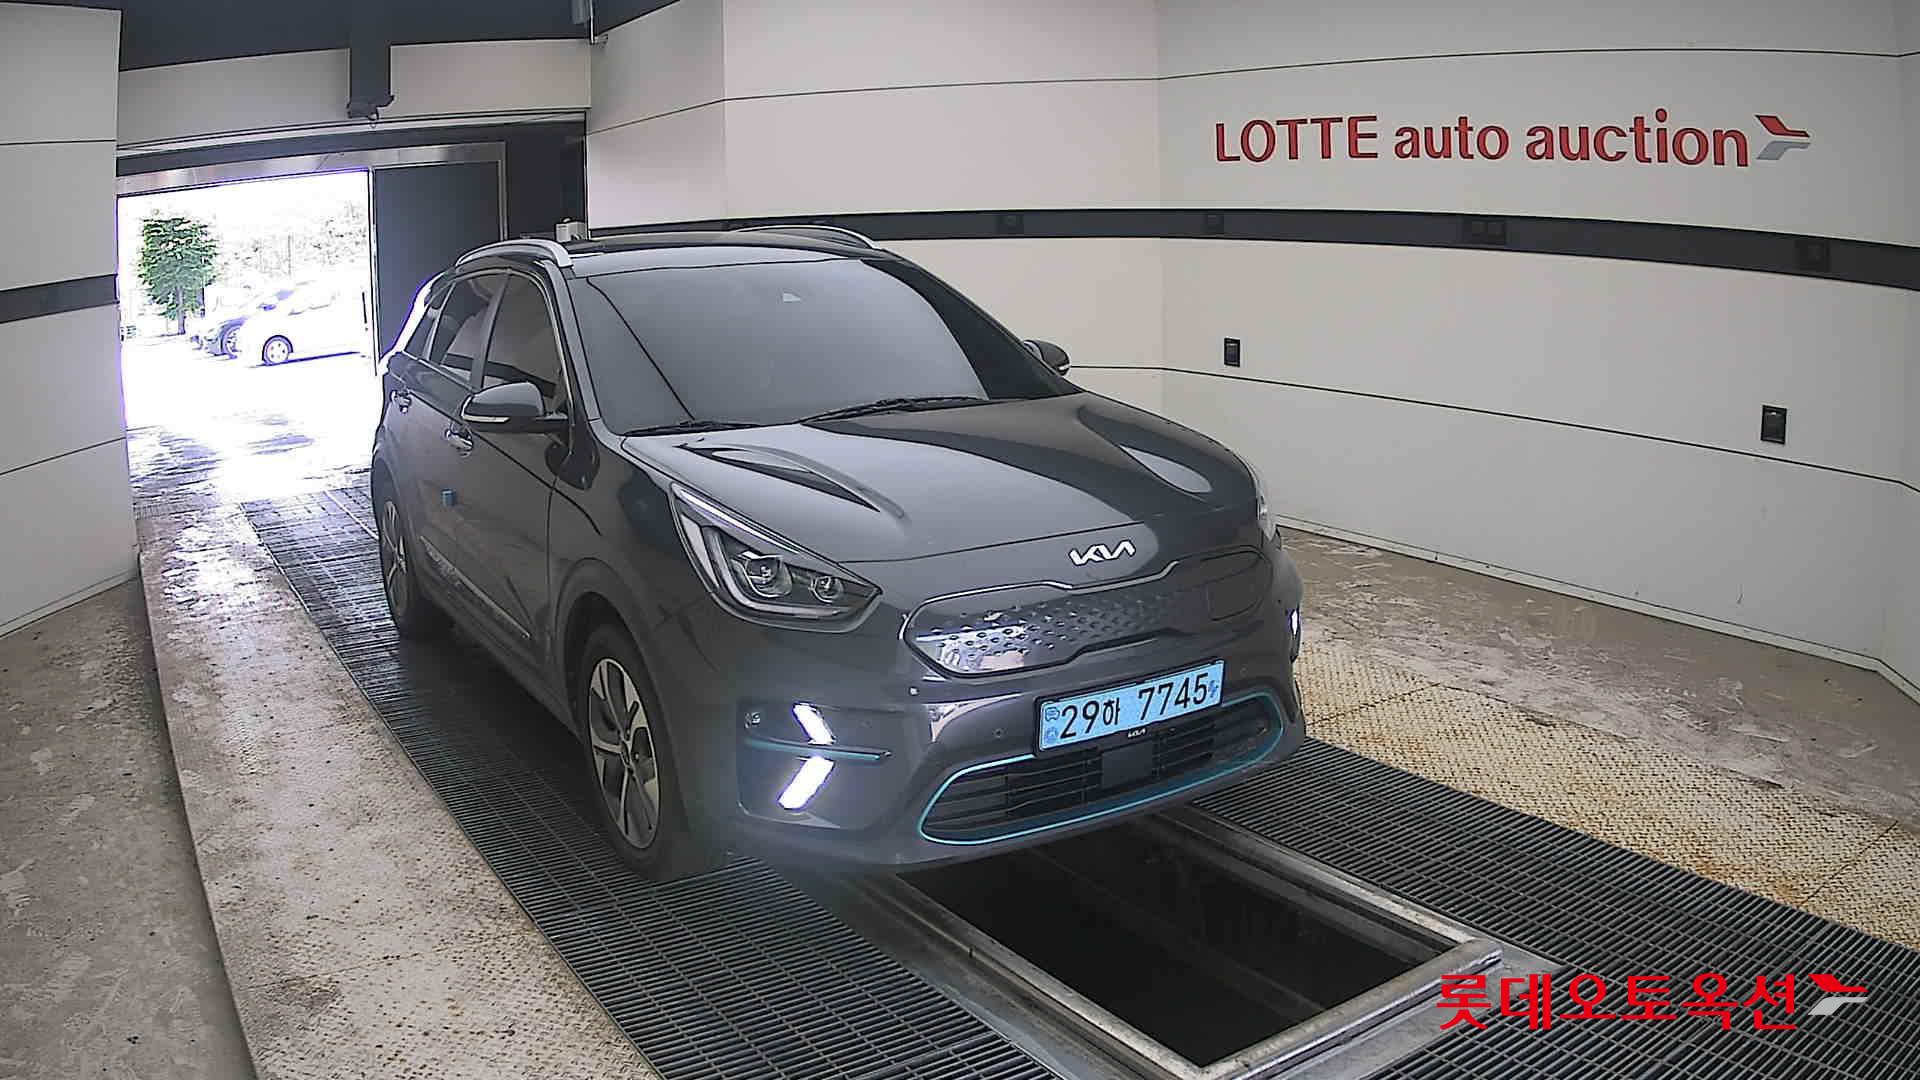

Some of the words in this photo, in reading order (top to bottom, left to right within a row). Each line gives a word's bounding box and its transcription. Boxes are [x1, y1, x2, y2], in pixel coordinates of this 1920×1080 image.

[1215, 115, 1378, 163] LOTTE
[1394, 115, 1511, 161] auto
[1526, 108, 1750, 168] auction
[1069, 540, 1136, 566] KIA
[1060, 697, 1121, 739] 29하
[1138, 673, 1209, 721] 7745
